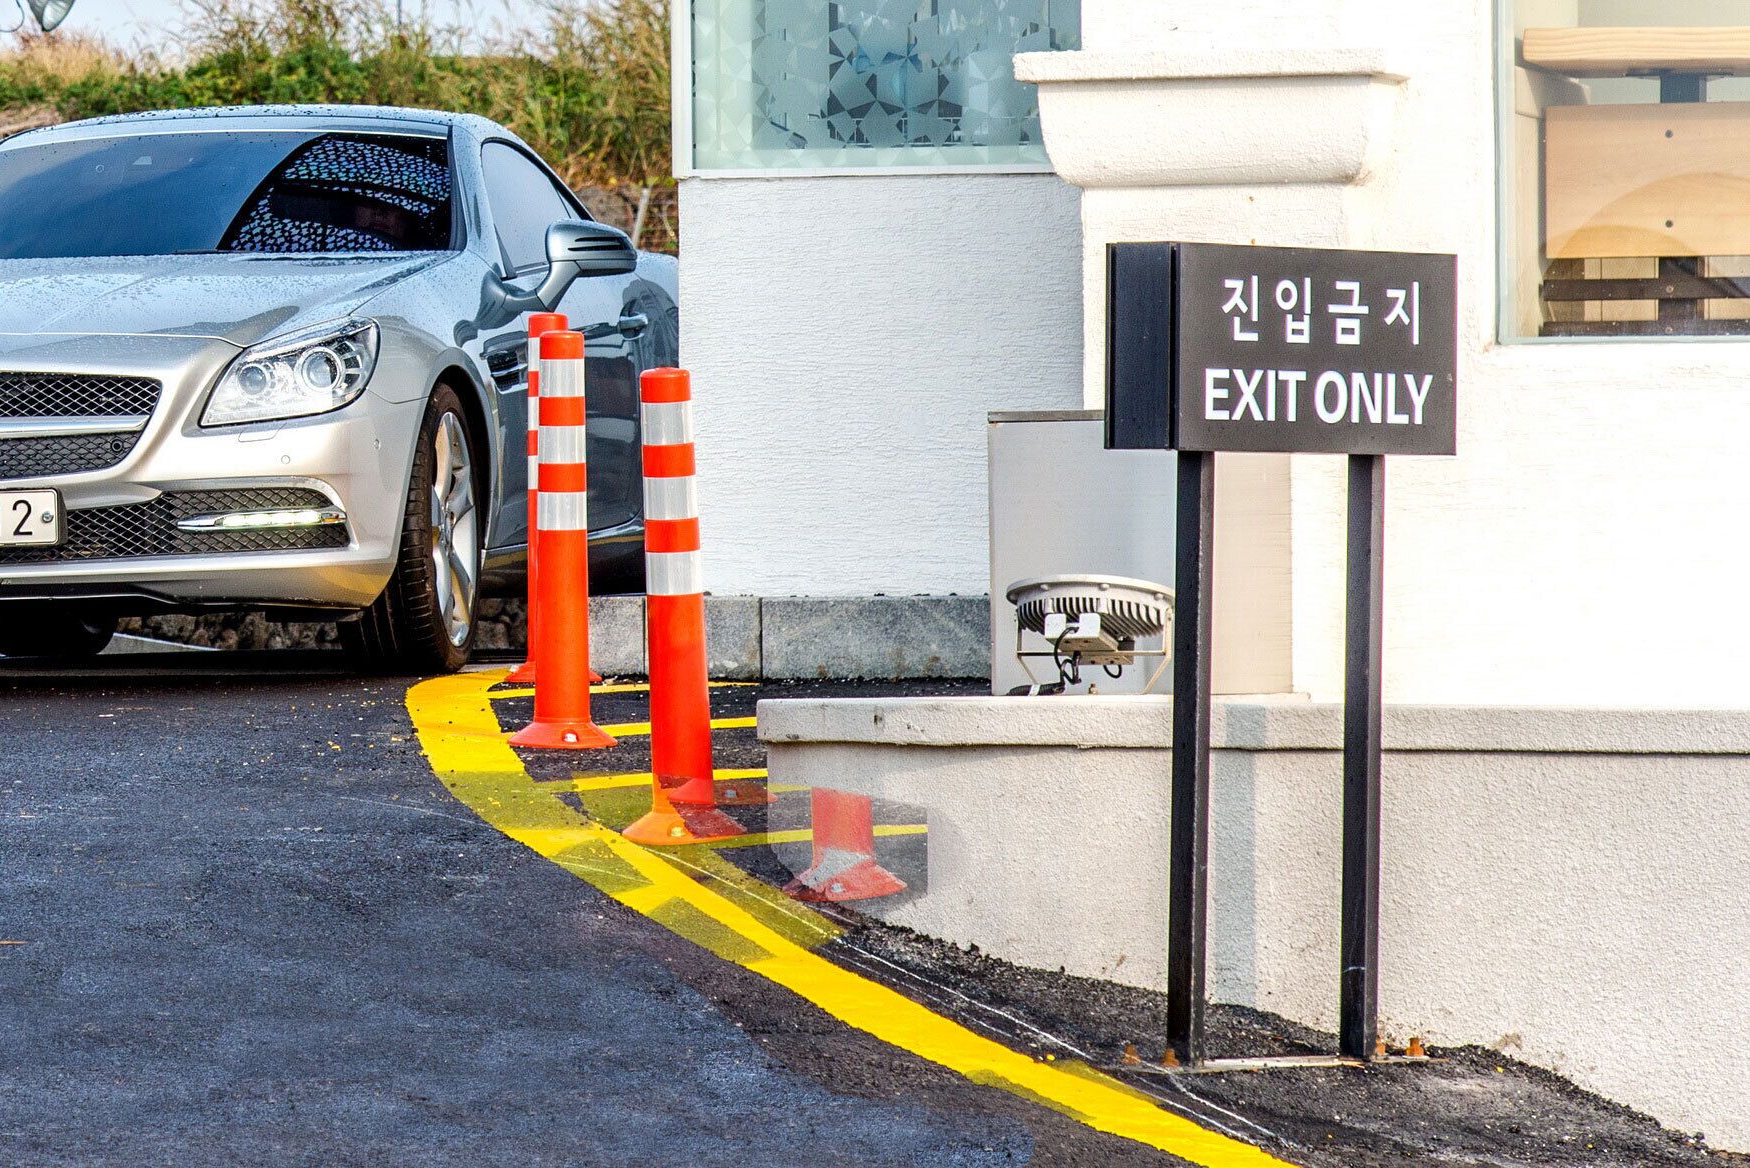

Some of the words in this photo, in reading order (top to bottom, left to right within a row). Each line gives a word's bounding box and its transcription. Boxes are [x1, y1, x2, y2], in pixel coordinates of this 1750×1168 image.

[1221, 275, 1419, 345] 진입금지
[1205, 368, 1307, 422] EXIT
[1314, 370, 1434, 425] ONLY
